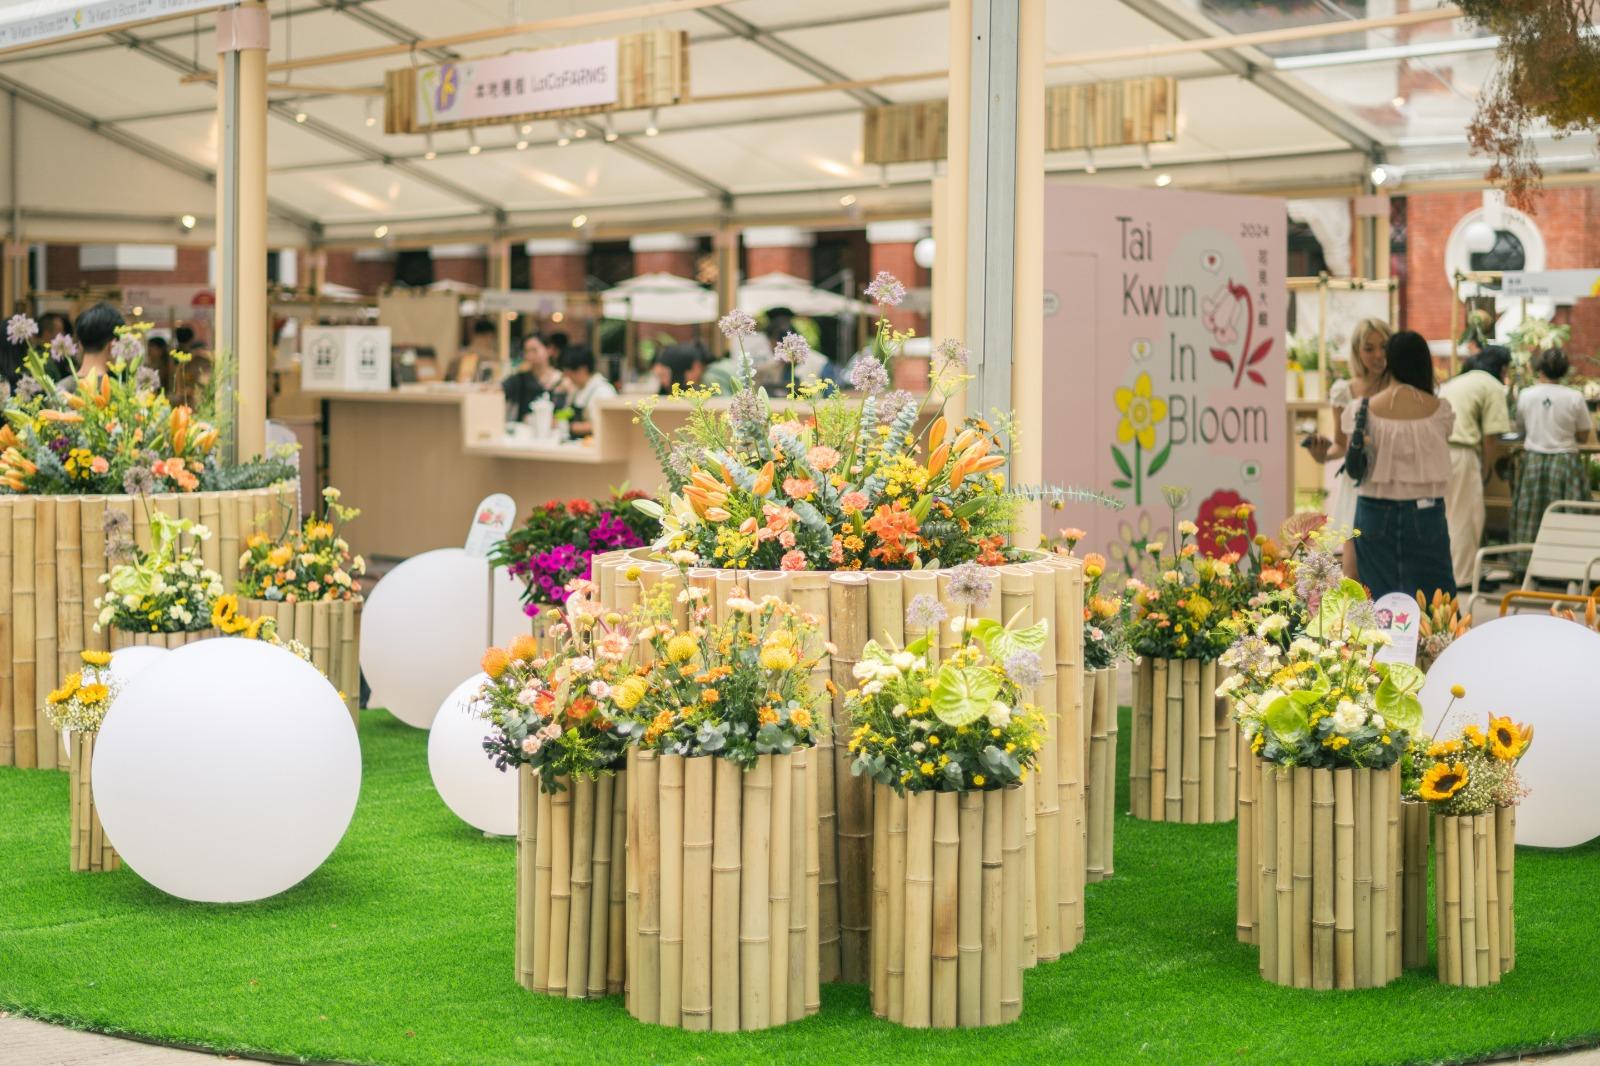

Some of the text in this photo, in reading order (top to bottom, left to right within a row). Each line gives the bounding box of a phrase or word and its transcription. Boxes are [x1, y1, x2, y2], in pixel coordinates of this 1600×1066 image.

[1115, 215, 1152, 261] Tai
[1240, 222, 1270, 239] 2024
[1122, 272, 1197, 318] Kwun
[1169, 331, 1197, 382] In
[1168, 394, 1268, 446] Bloom
